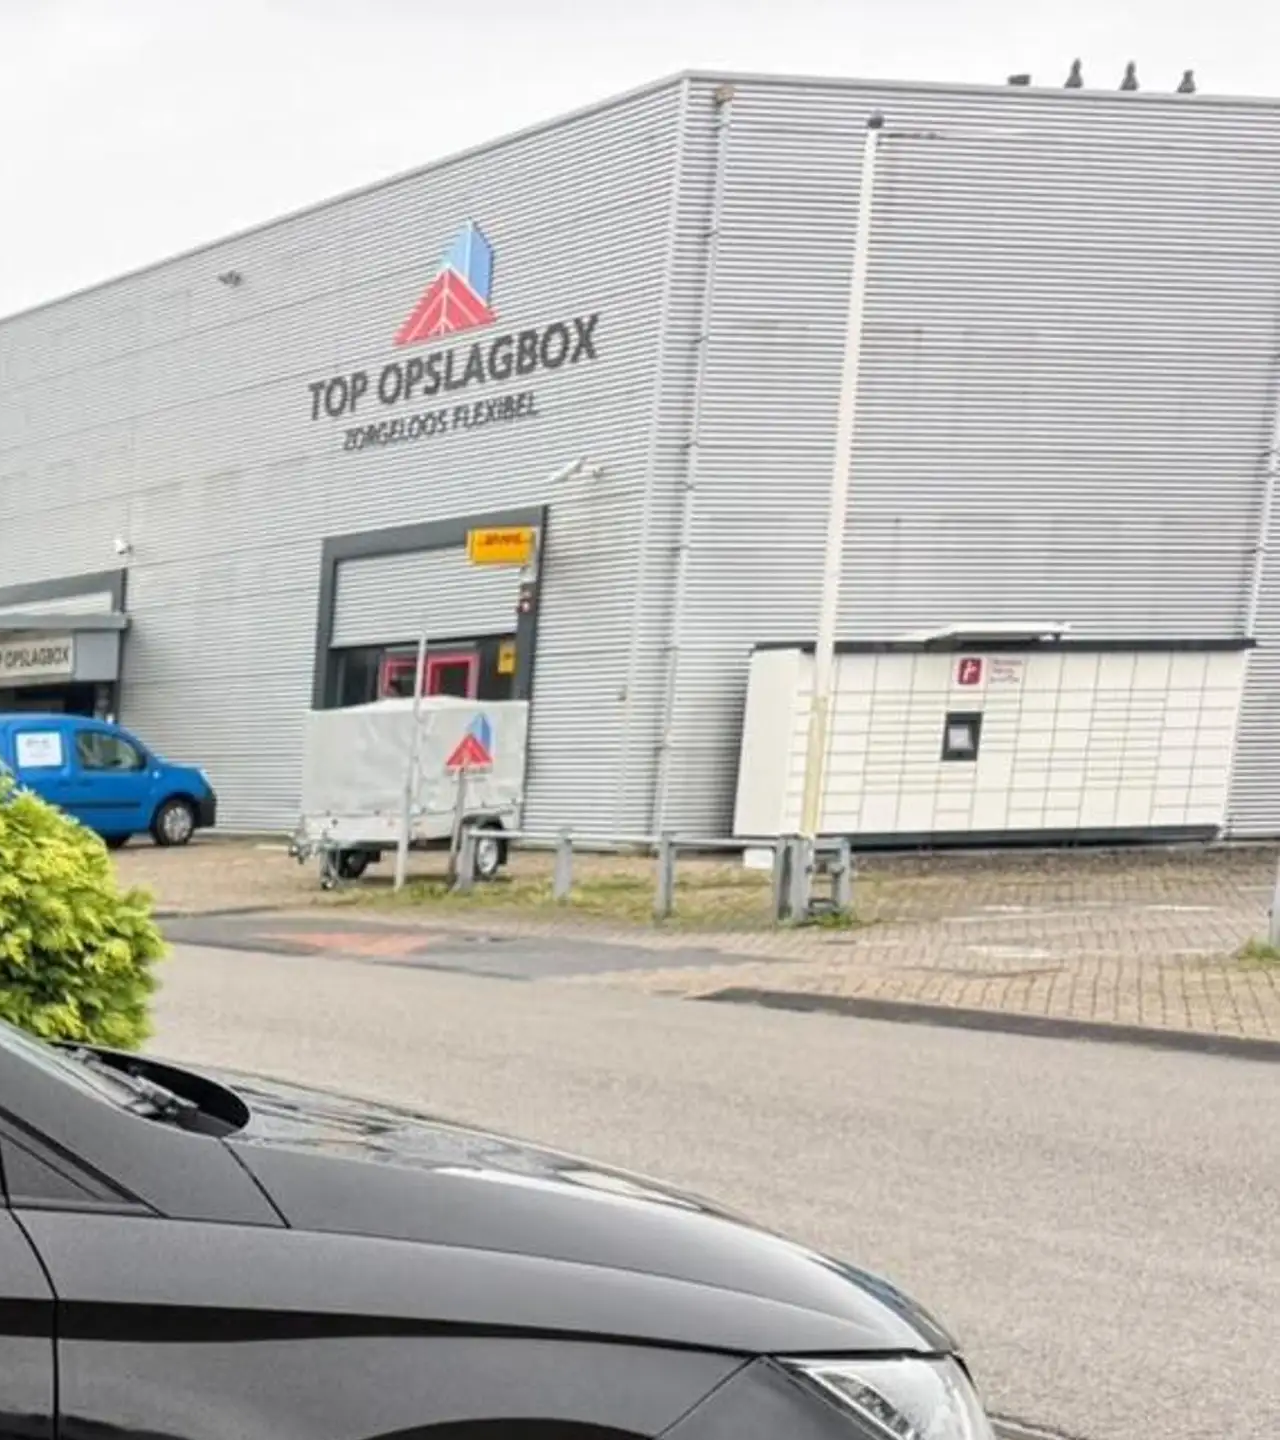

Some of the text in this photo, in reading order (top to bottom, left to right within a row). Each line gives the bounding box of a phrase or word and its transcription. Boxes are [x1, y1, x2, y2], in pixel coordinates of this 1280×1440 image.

[307, 312, 600, 421] TOP OPSLAGBOX
[451, 391, 539, 430] FLEXIBEL
